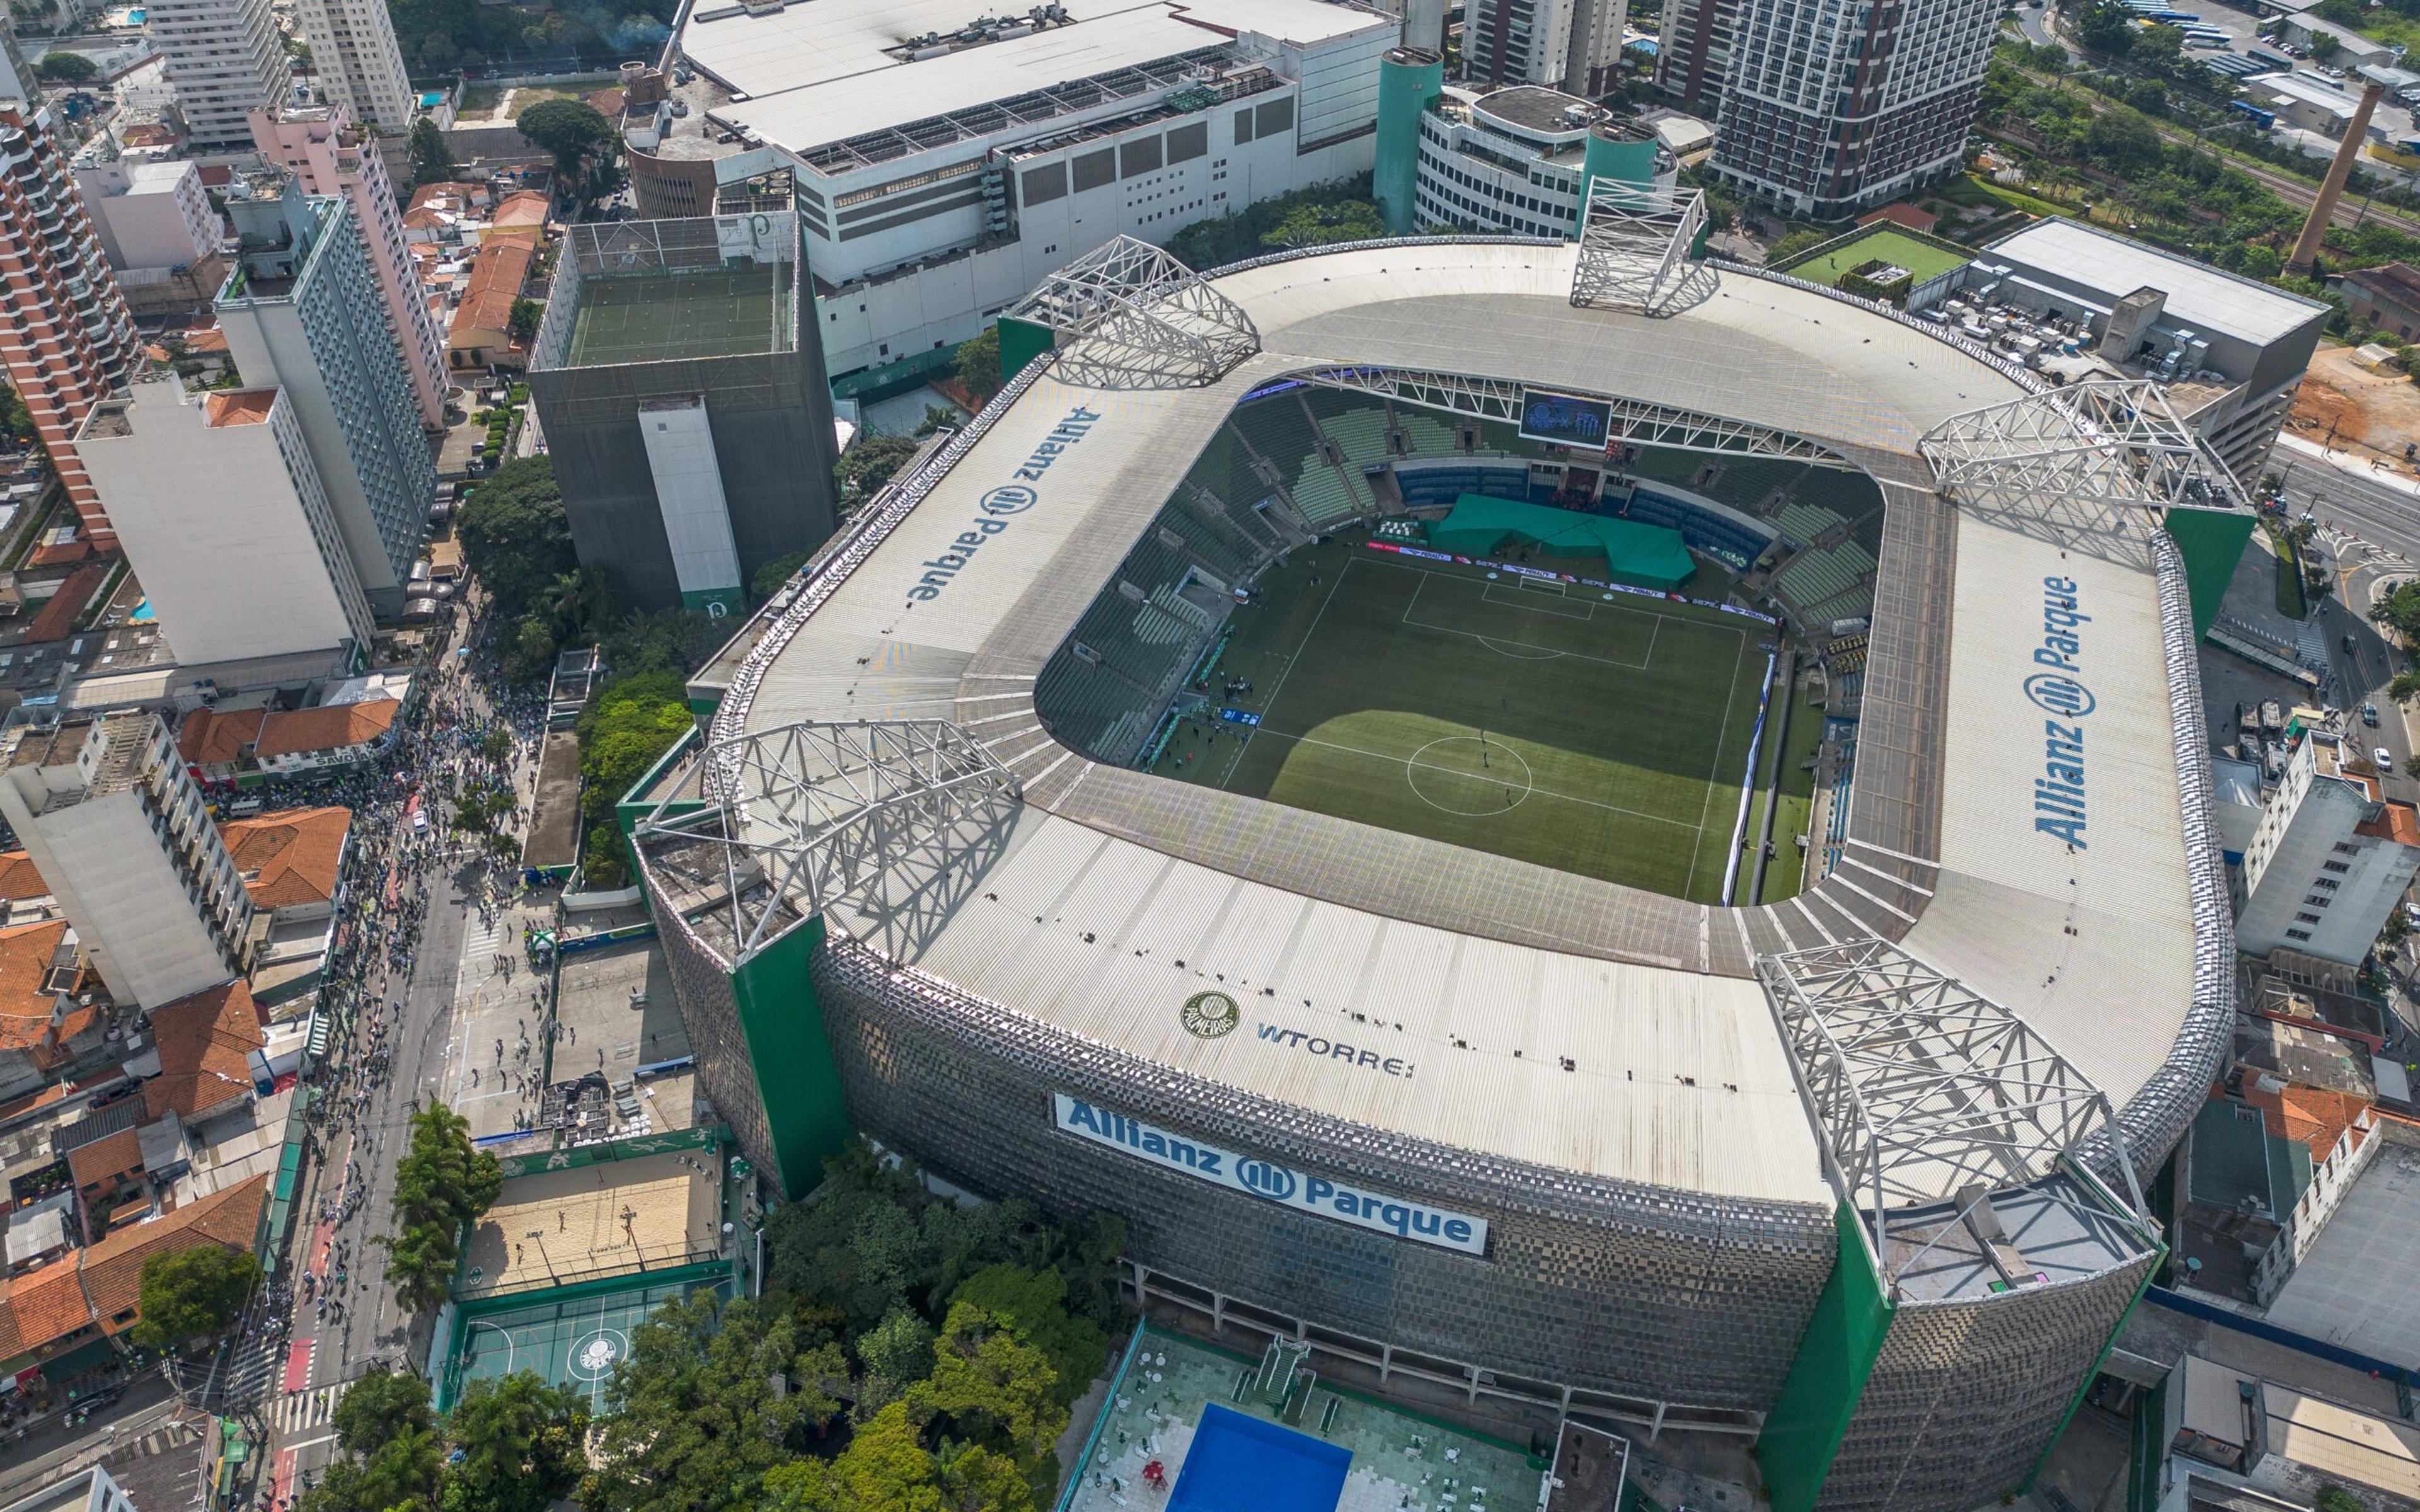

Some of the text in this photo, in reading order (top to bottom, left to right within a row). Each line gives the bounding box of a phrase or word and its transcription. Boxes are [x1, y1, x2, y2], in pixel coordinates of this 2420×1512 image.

[907, 407, 1102, 601] Allianz Parque
[1420, 551, 1444, 560] PENALTY
[1525, 568, 1550, 577] PENALTY
[1633, 588, 1659, 597] PENALTY
[1744, 609, 1770, 621] PENALTY
[2034, 576, 2092, 850] Allianz Parque
[1184, 1007, 1234, 1036] PALMEIRAS
[1257, 1022, 1404, 1076] WTORRE
[1068, 1099, 1472, 1243] Allianz Parque
